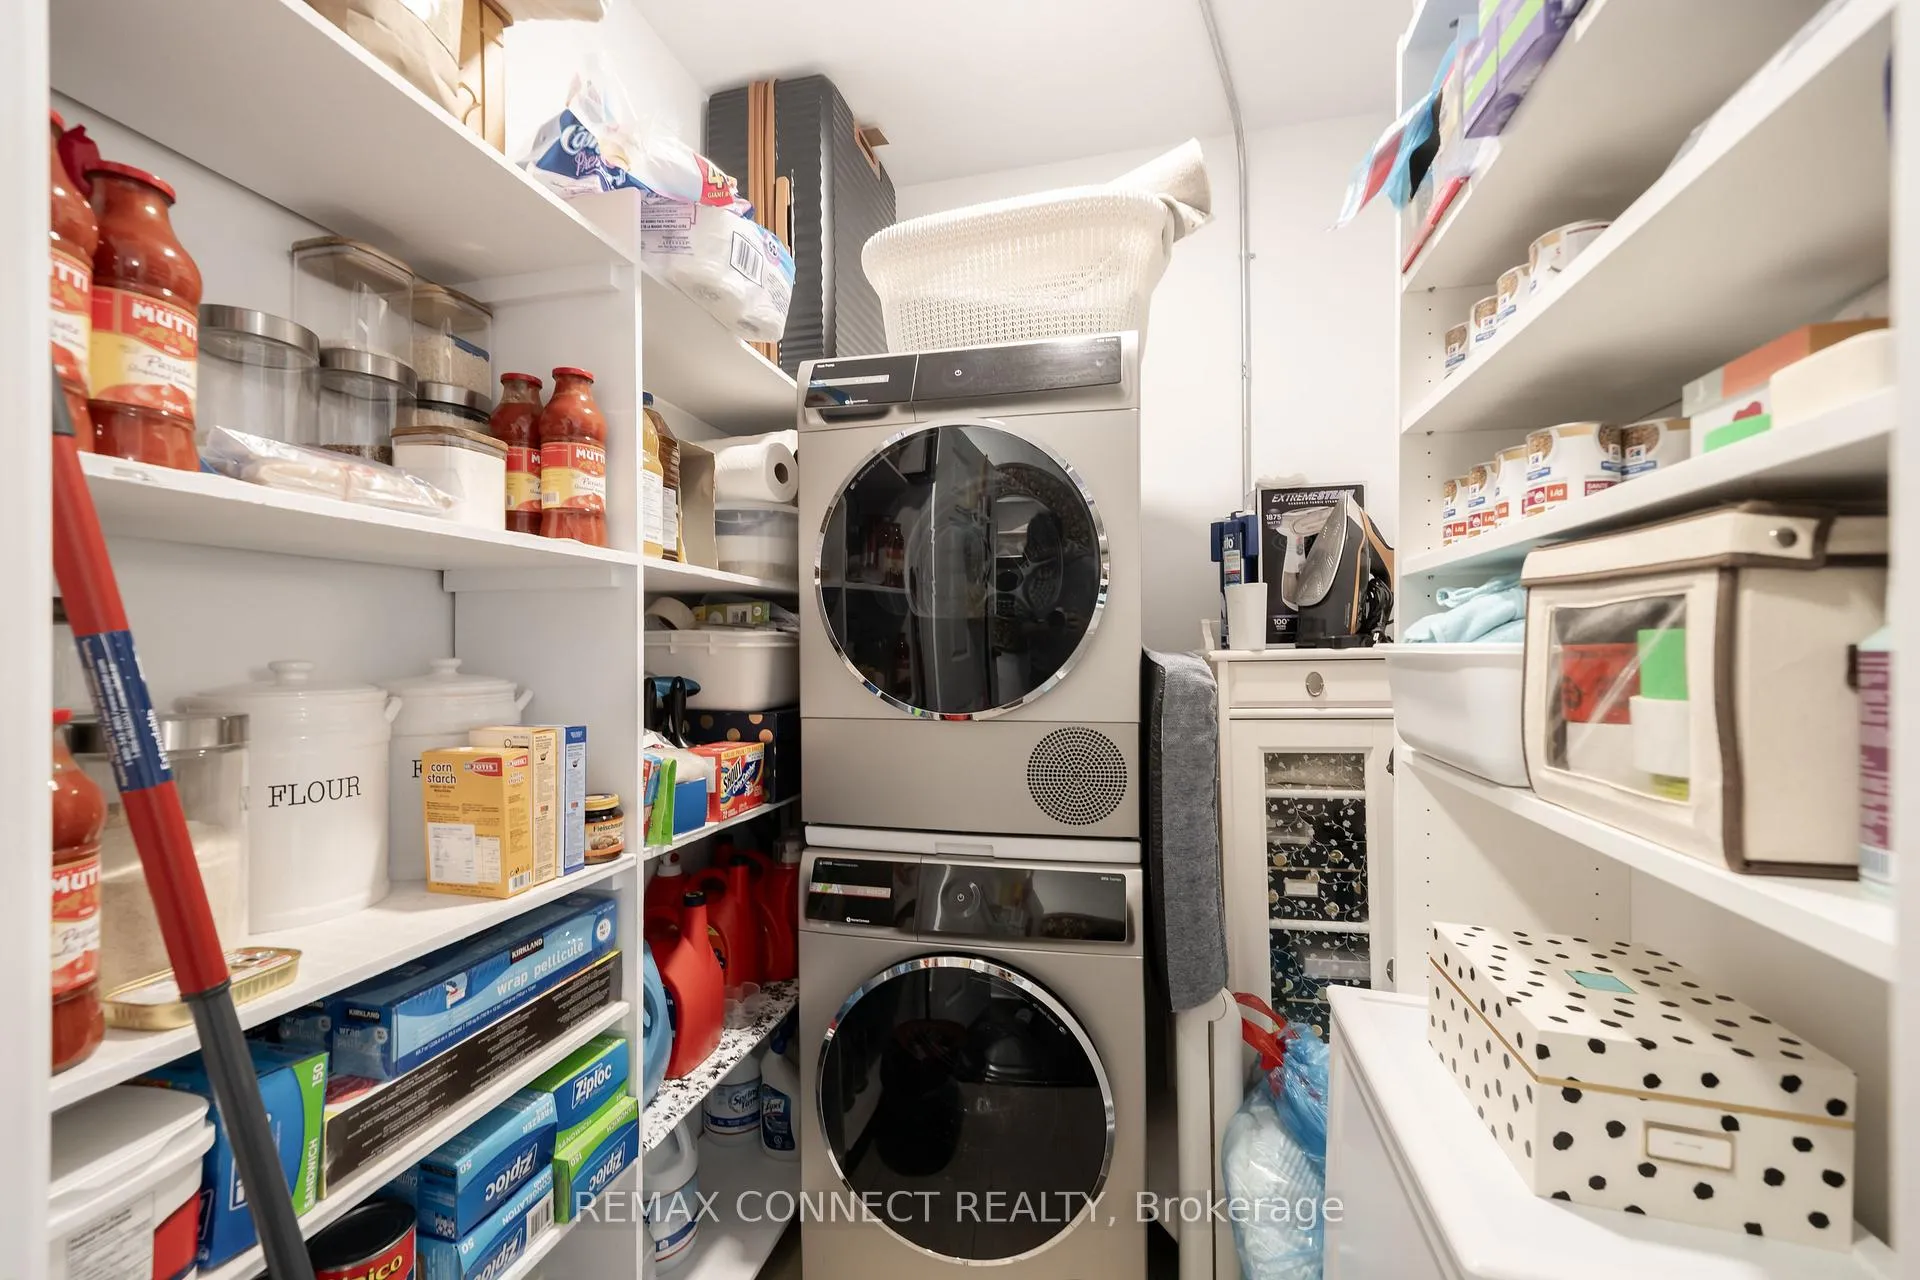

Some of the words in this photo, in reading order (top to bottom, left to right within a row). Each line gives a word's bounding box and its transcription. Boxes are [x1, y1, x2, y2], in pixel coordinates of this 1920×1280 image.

[132, 302, 197, 341] MUTTI
[146, 709, 171, 770] Extendable
[427, 774, 457, 784] starch
[431, 763, 452, 772] corn
[723, 757, 742, 793] SHOUT
[268, 775, 362, 808] FLOUR
[512, 938, 543, 959] KIRKLAND
[497, 972, 528, 996] wrap
[348, 1008, 380, 1020] KIRKLAND
[311, 1062, 324, 1087] 150
[575, 1064, 612, 1101] Ziploc
[304, 1137, 318, 1210] SANDWICH
[485, 1150, 535, 1201] Ziploc
[589, 1150, 622, 1192] Ziploc
[341, 1255, 403, 1280] ico
